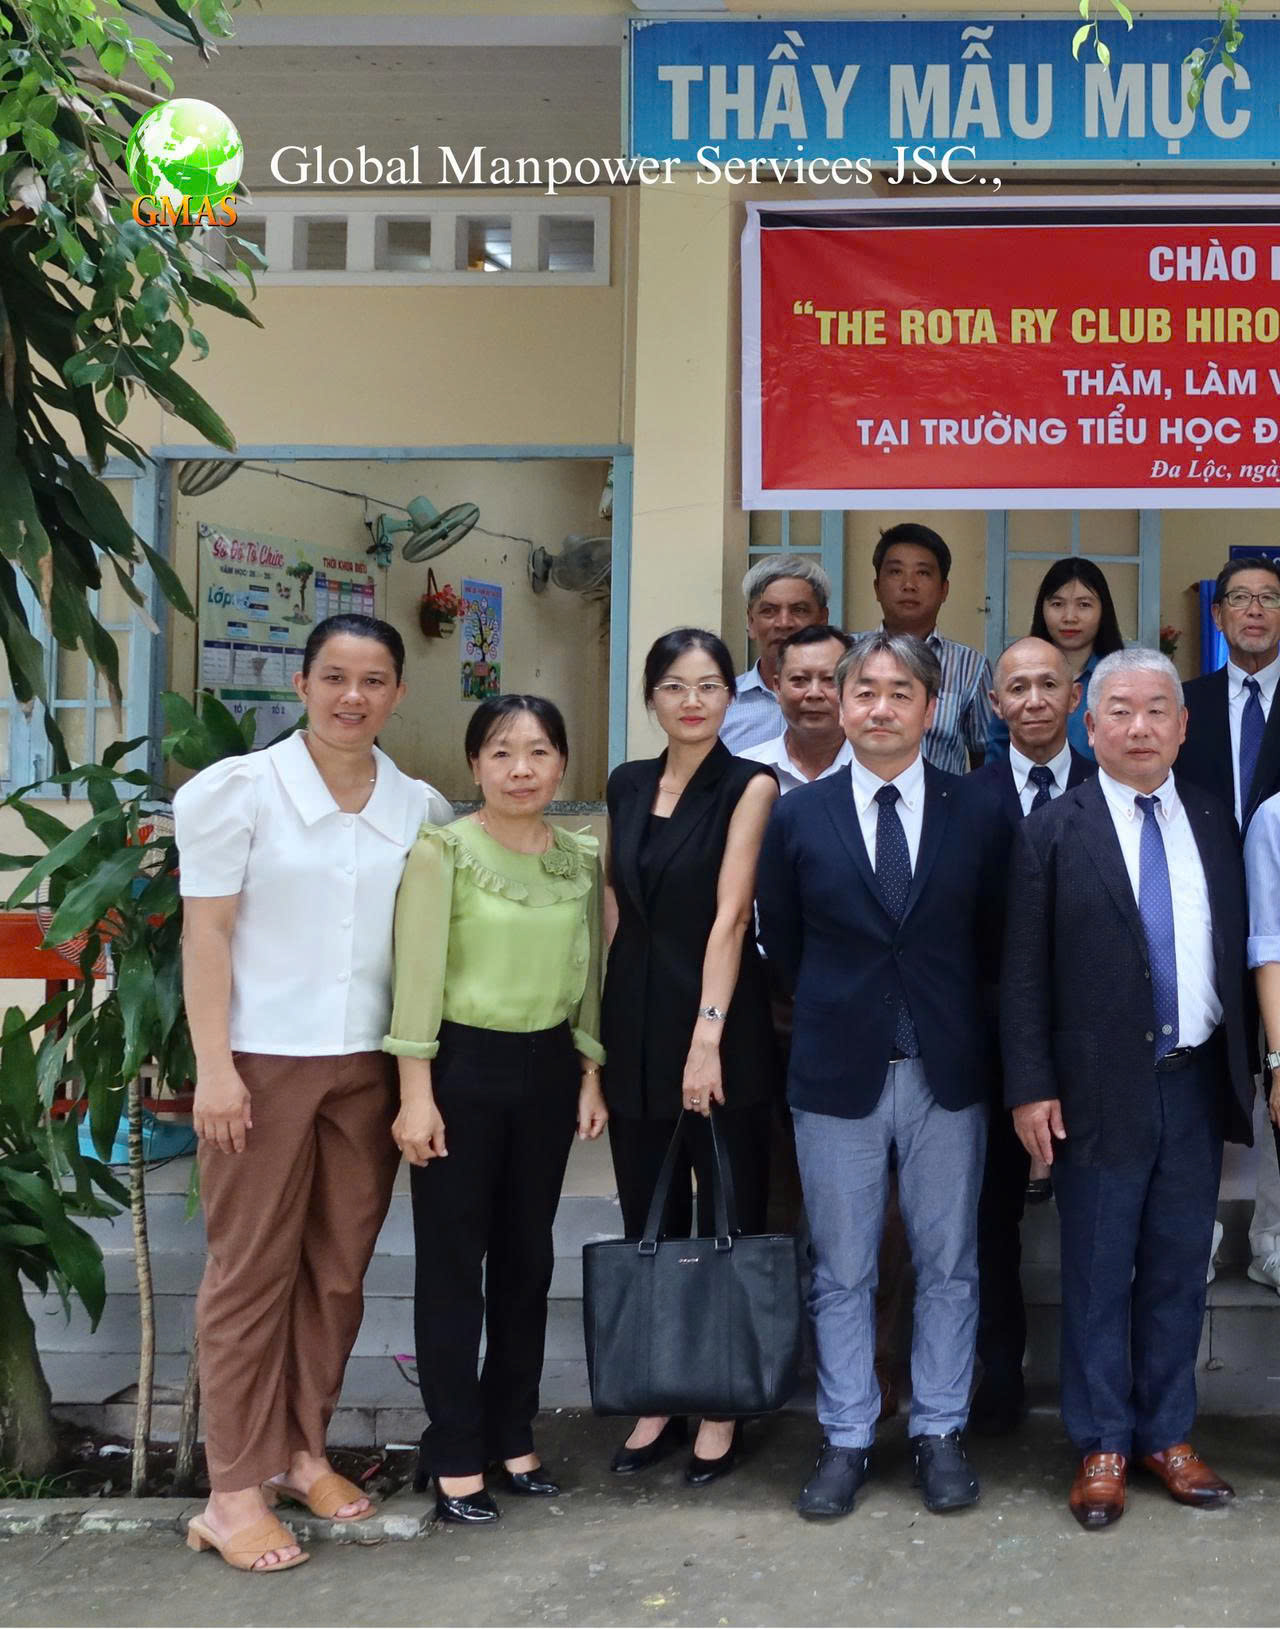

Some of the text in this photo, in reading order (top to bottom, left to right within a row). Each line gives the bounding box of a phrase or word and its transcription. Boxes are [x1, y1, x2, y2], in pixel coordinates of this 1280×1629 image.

[658, 30, 860, 139] THẦY
[889, 25, 1053, 139] MẪU
[1085, 62, 1251, 155] MỤC
[1150, 237, 1255, 281] CHÀO
[901, 309, 997, 344] ROTA
[1012, 309, 1057, 343] RY
[1072, 309, 1171, 343] CLUB
[1063, 364, 1171, 400] THĂM,
[1186, 362, 1256, 394] LÀM
[857, 420, 908, 453] TẠI
[921, 411, 1067, 445] TRƯỜNG
[1078, 404, 1146, 444] TIỂU
[1161, 418, 1240, 452] HỌC
[1151, 461, 1180, 477] Đa
[1188, 460, 1231, 482] Lộc,
